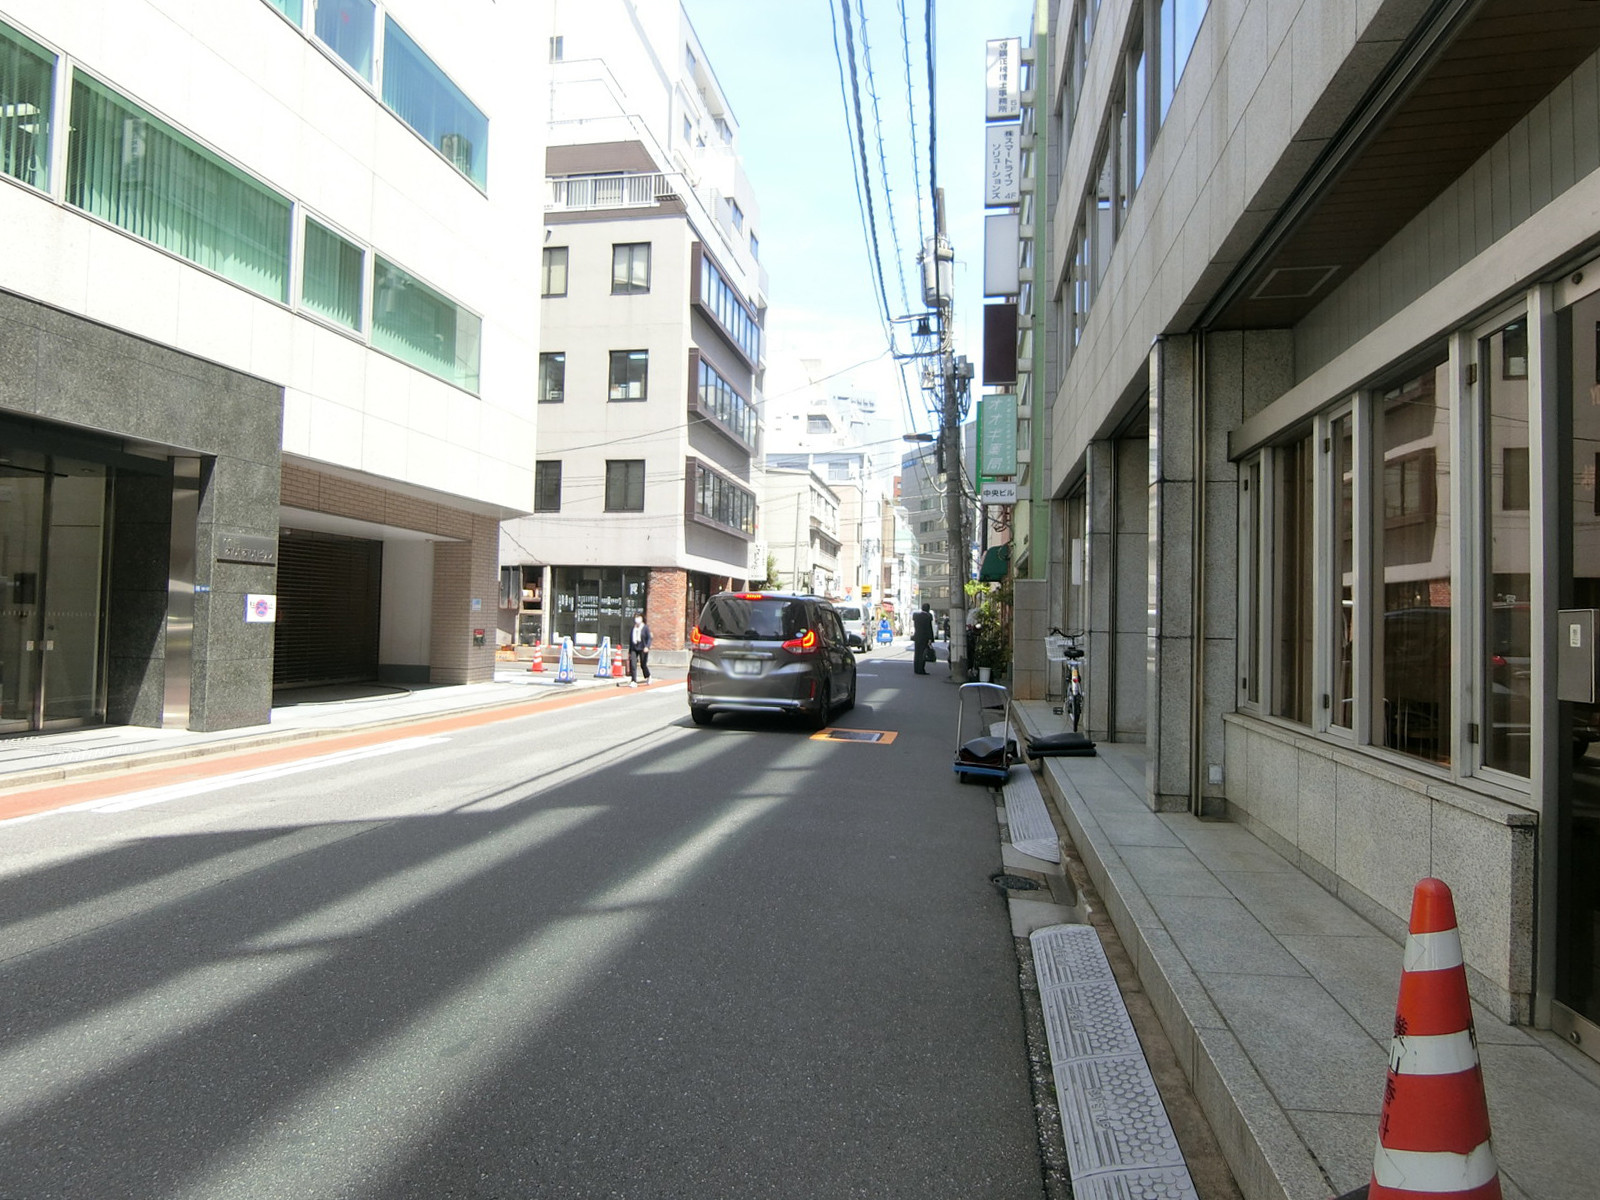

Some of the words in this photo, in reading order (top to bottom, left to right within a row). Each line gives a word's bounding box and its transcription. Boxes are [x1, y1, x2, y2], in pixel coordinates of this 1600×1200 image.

[992, 144, 1001, 199] ソリューションズ
